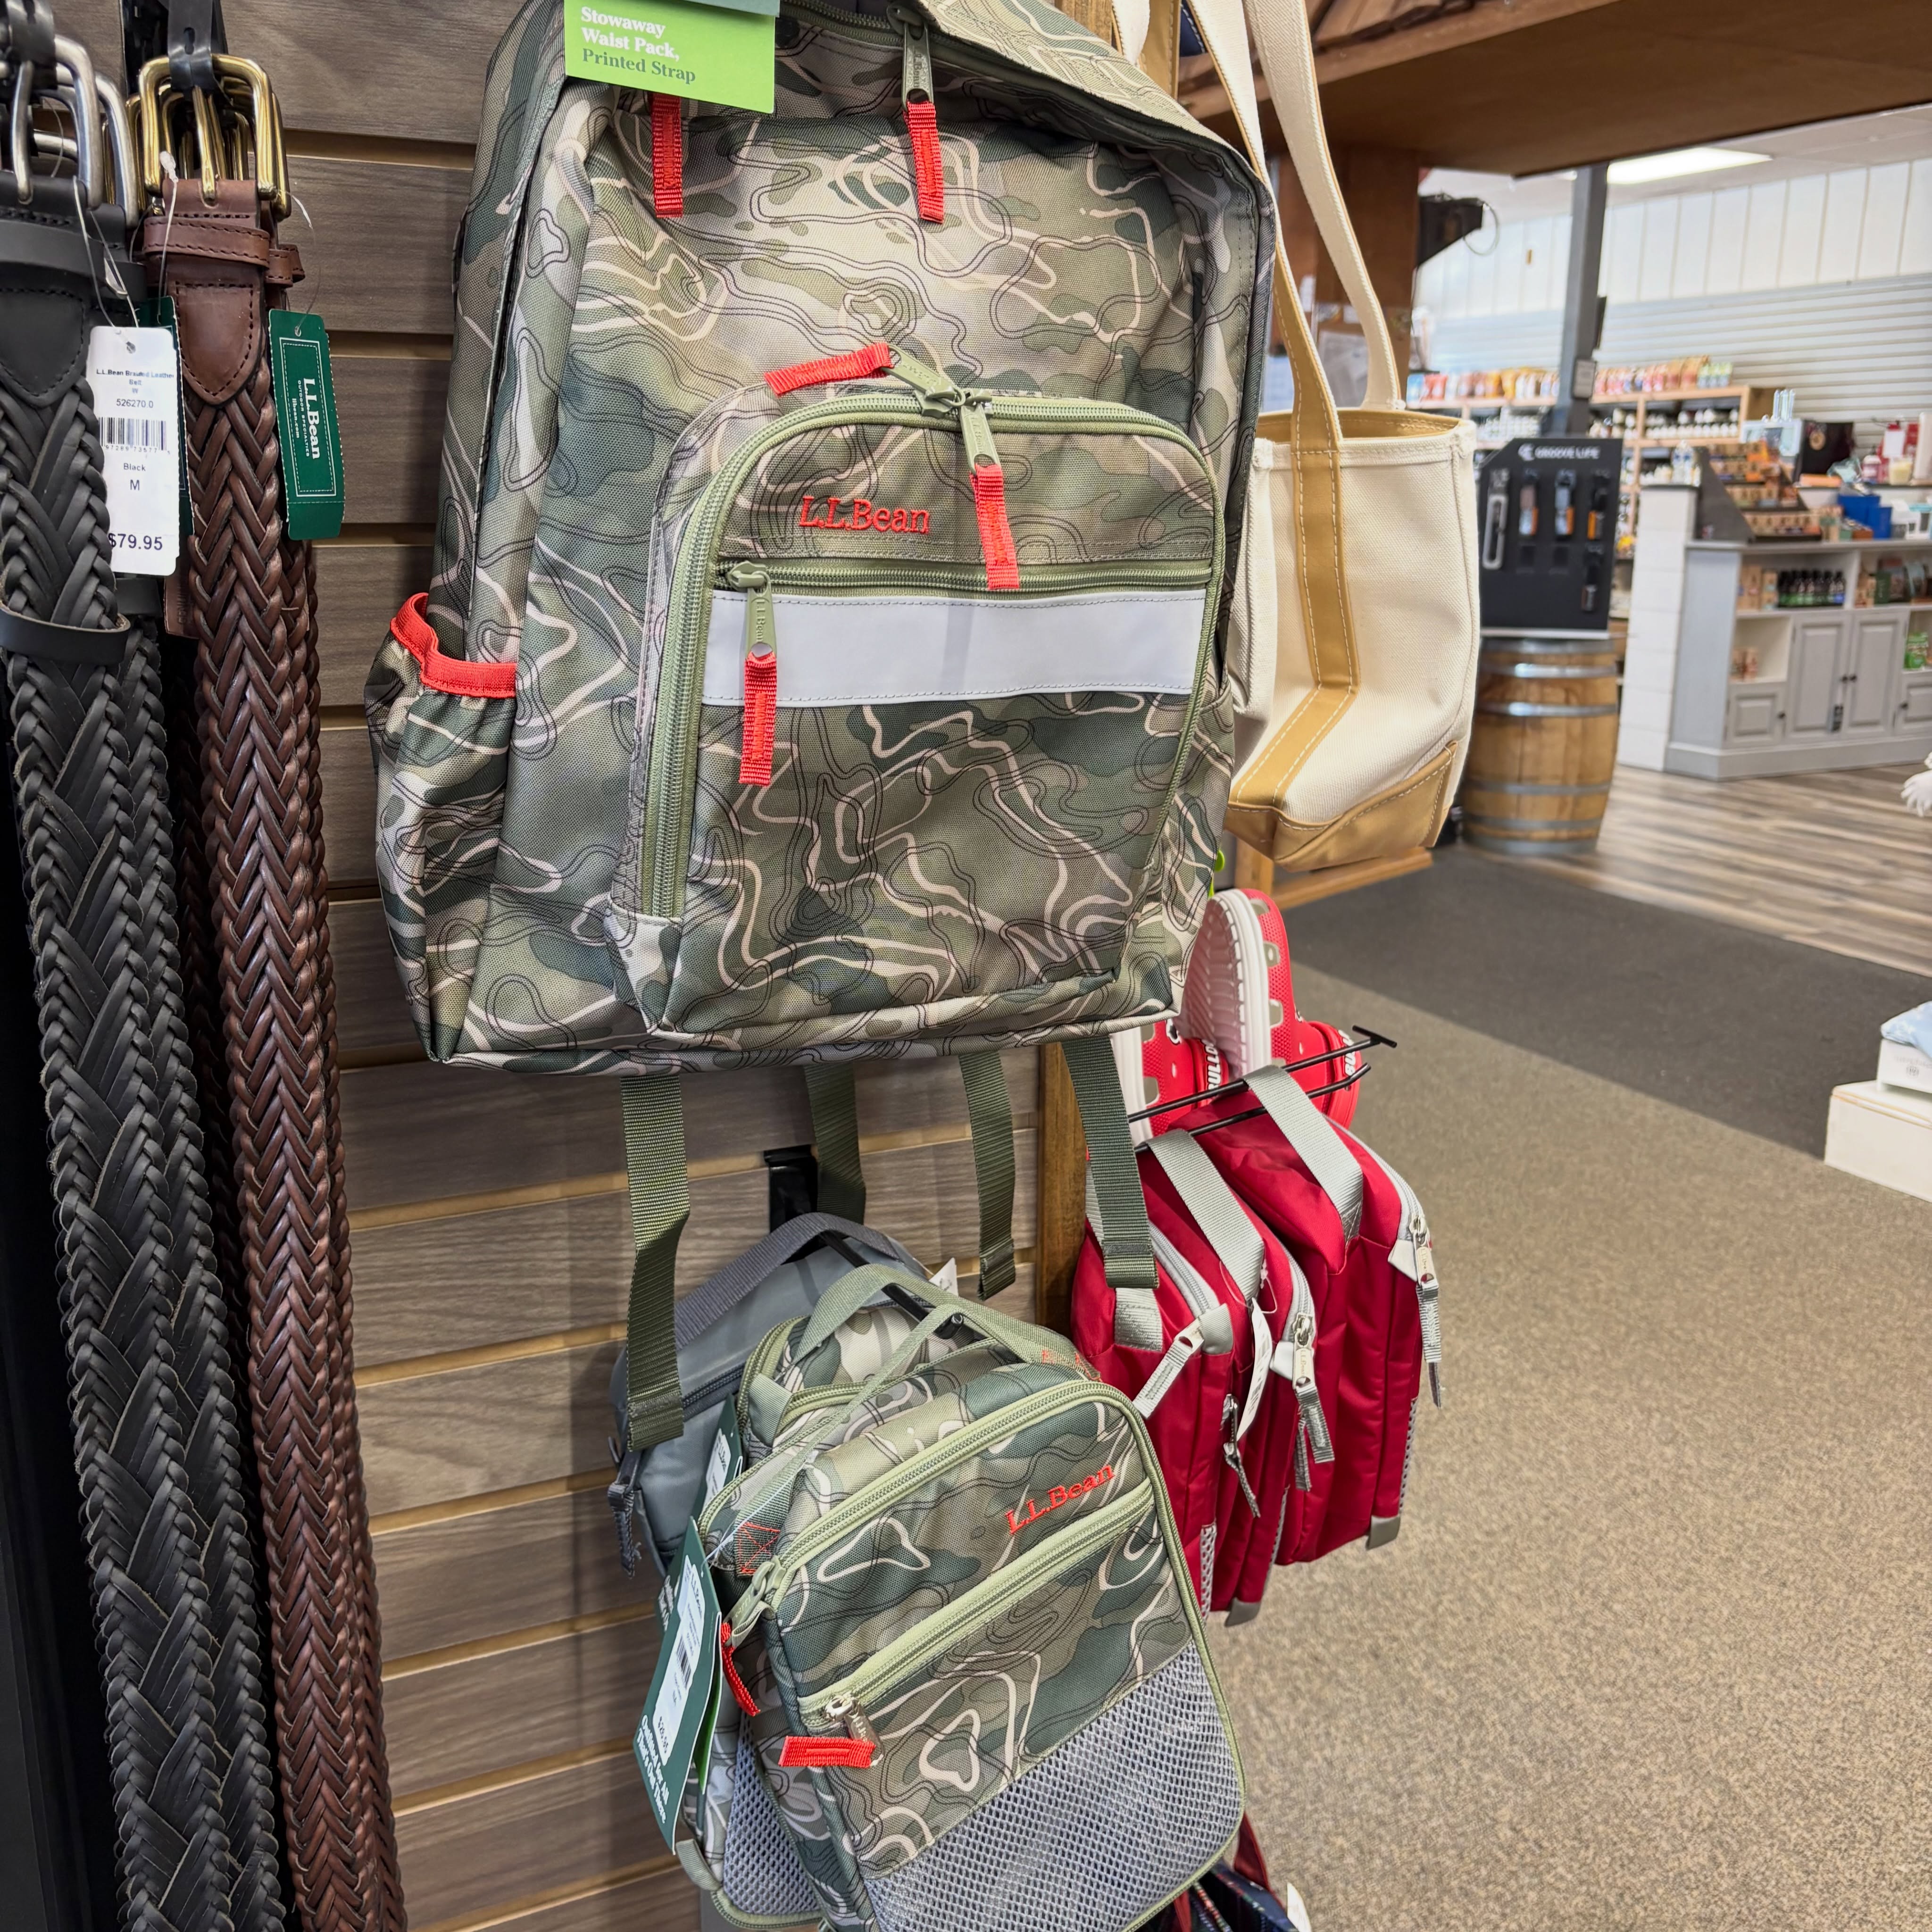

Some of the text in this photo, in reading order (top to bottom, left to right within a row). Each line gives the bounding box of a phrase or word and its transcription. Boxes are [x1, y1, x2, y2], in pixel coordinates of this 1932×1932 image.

[581, 6, 666, 39] Stowaway
[581, 27, 680, 61] Waist Pack,
[582, 48, 696, 84] Printed Strap
[301, 415, 310, 457] SPECIALTIES
[303, 378, 320, 459] L.L.Bean
[124, 463, 146, 472] Black
[130, 479, 140, 491] M
[799, 495, 930, 534] L.L.Bean
[108, 533, 163, 550] $79.95
[1005, 1465, 1116, 1535] L.L.Bean
